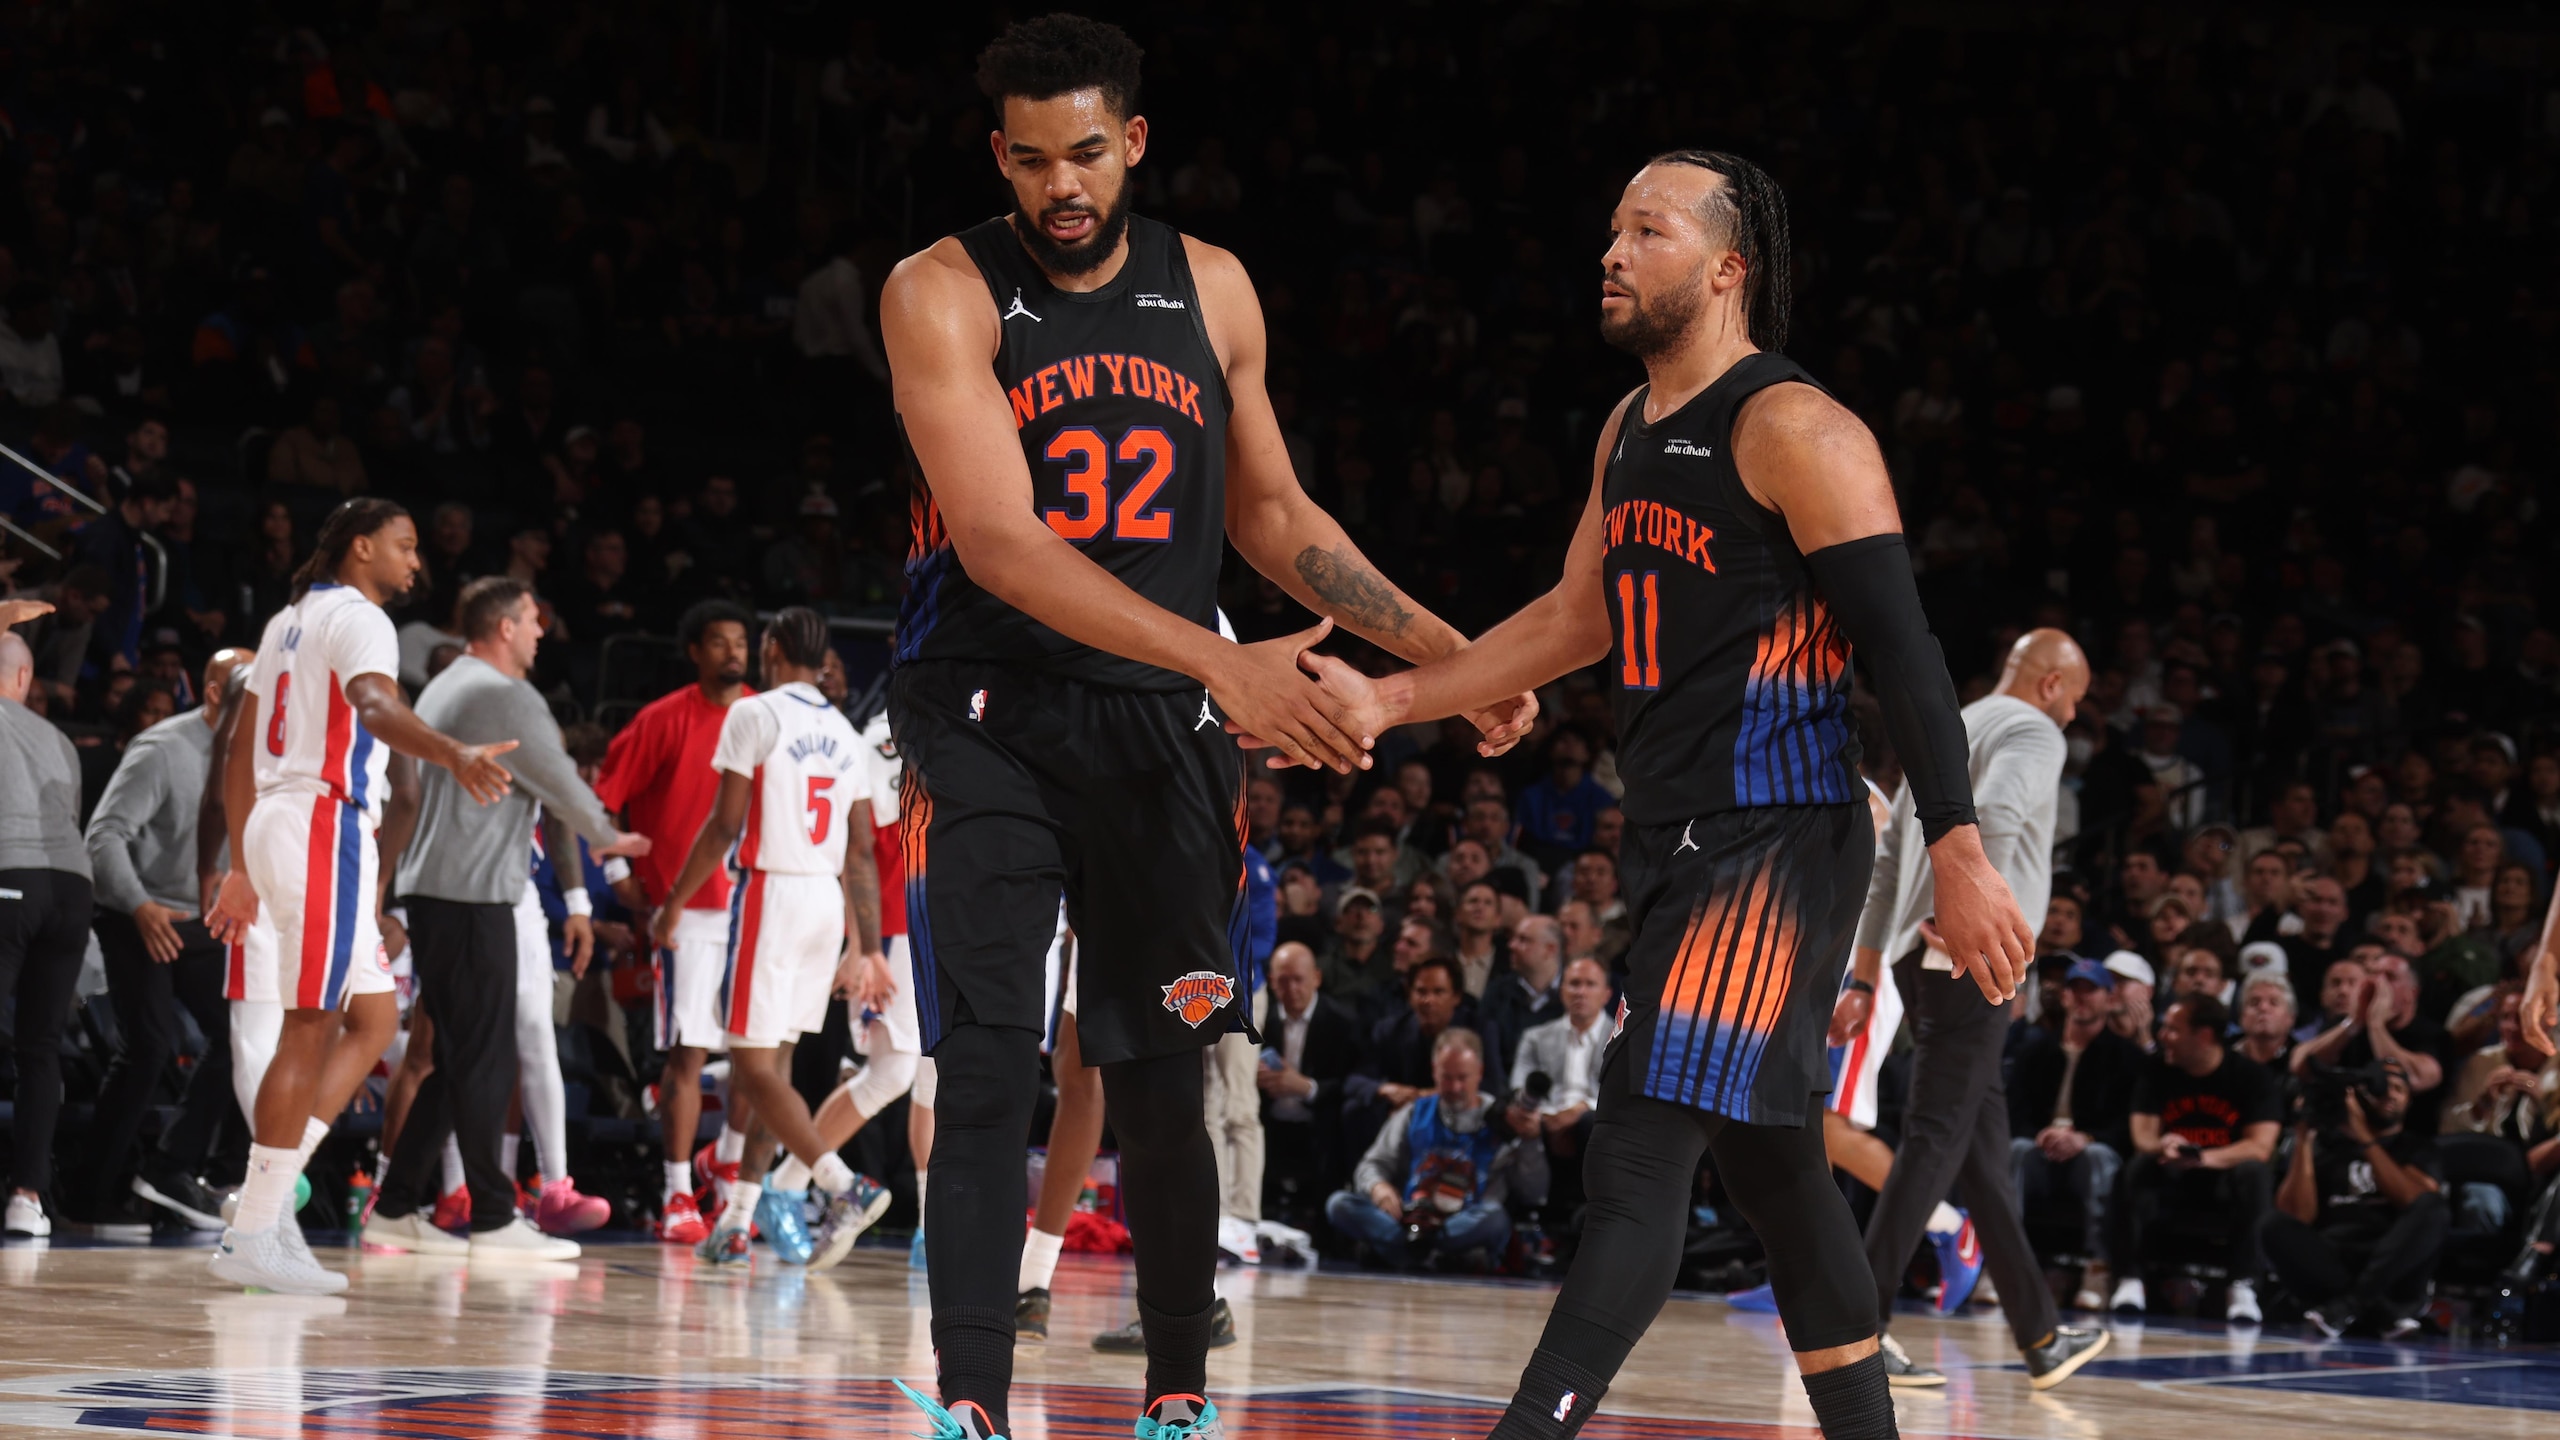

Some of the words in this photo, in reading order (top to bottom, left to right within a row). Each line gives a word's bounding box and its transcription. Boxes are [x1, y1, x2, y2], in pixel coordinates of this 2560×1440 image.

[1136, 298, 1157, 307] abu
[1157, 299, 1185, 309] dhabi
[1008, 354, 1097, 431] NEW
[1099, 353, 1205, 428] YORK
[1043, 425, 1176, 542] 32
[1664, 443, 1682, 454] abu
[1682, 445, 1712, 458] dhabi
[1602, 501, 1631, 559] EW
[1632, 499, 1718, 575] YORK
[1616, 569, 1661, 691] 11
[806, 774, 836, 846] 5
[1165, 976, 1232, 1006] KNICKS
